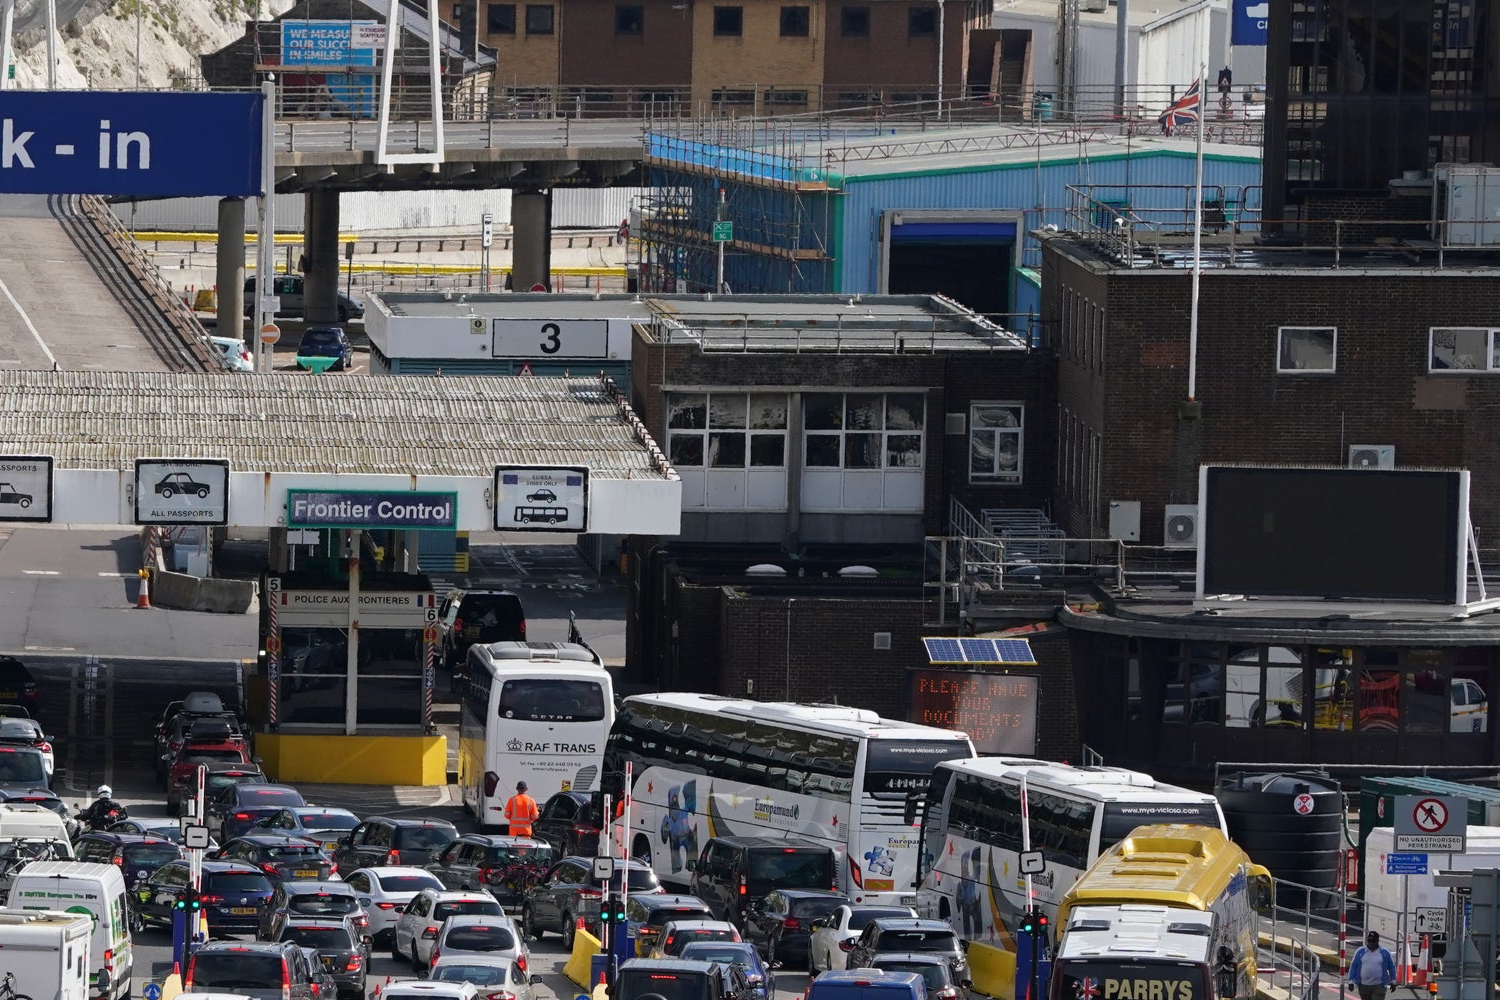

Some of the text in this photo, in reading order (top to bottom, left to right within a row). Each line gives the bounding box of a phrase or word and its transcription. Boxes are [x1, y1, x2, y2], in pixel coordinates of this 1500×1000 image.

[289, 28, 307, 39] WE
[289, 39, 314, 49] OUR
[289, 50, 342, 60] IN SMILES
[99, 119, 151, 170] in
[540, 323, 561, 355] 3
[150, 510, 215, 518] ALL PASSPORTS
[294, 500, 451, 520] Frontier Control
[270, 579, 279, 590] 5
[295, 595, 329, 604] POLICE
[357, 596, 410, 605] RONTIERES
[427, 610, 436, 621] 6
[919, 680, 1029, 698] PLEASE HAVE
[953, 697, 991, 712] YOUR
[923, 710, 1021, 727] DOCUMENTS
[525, 743, 596, 754] RAF TRANS
